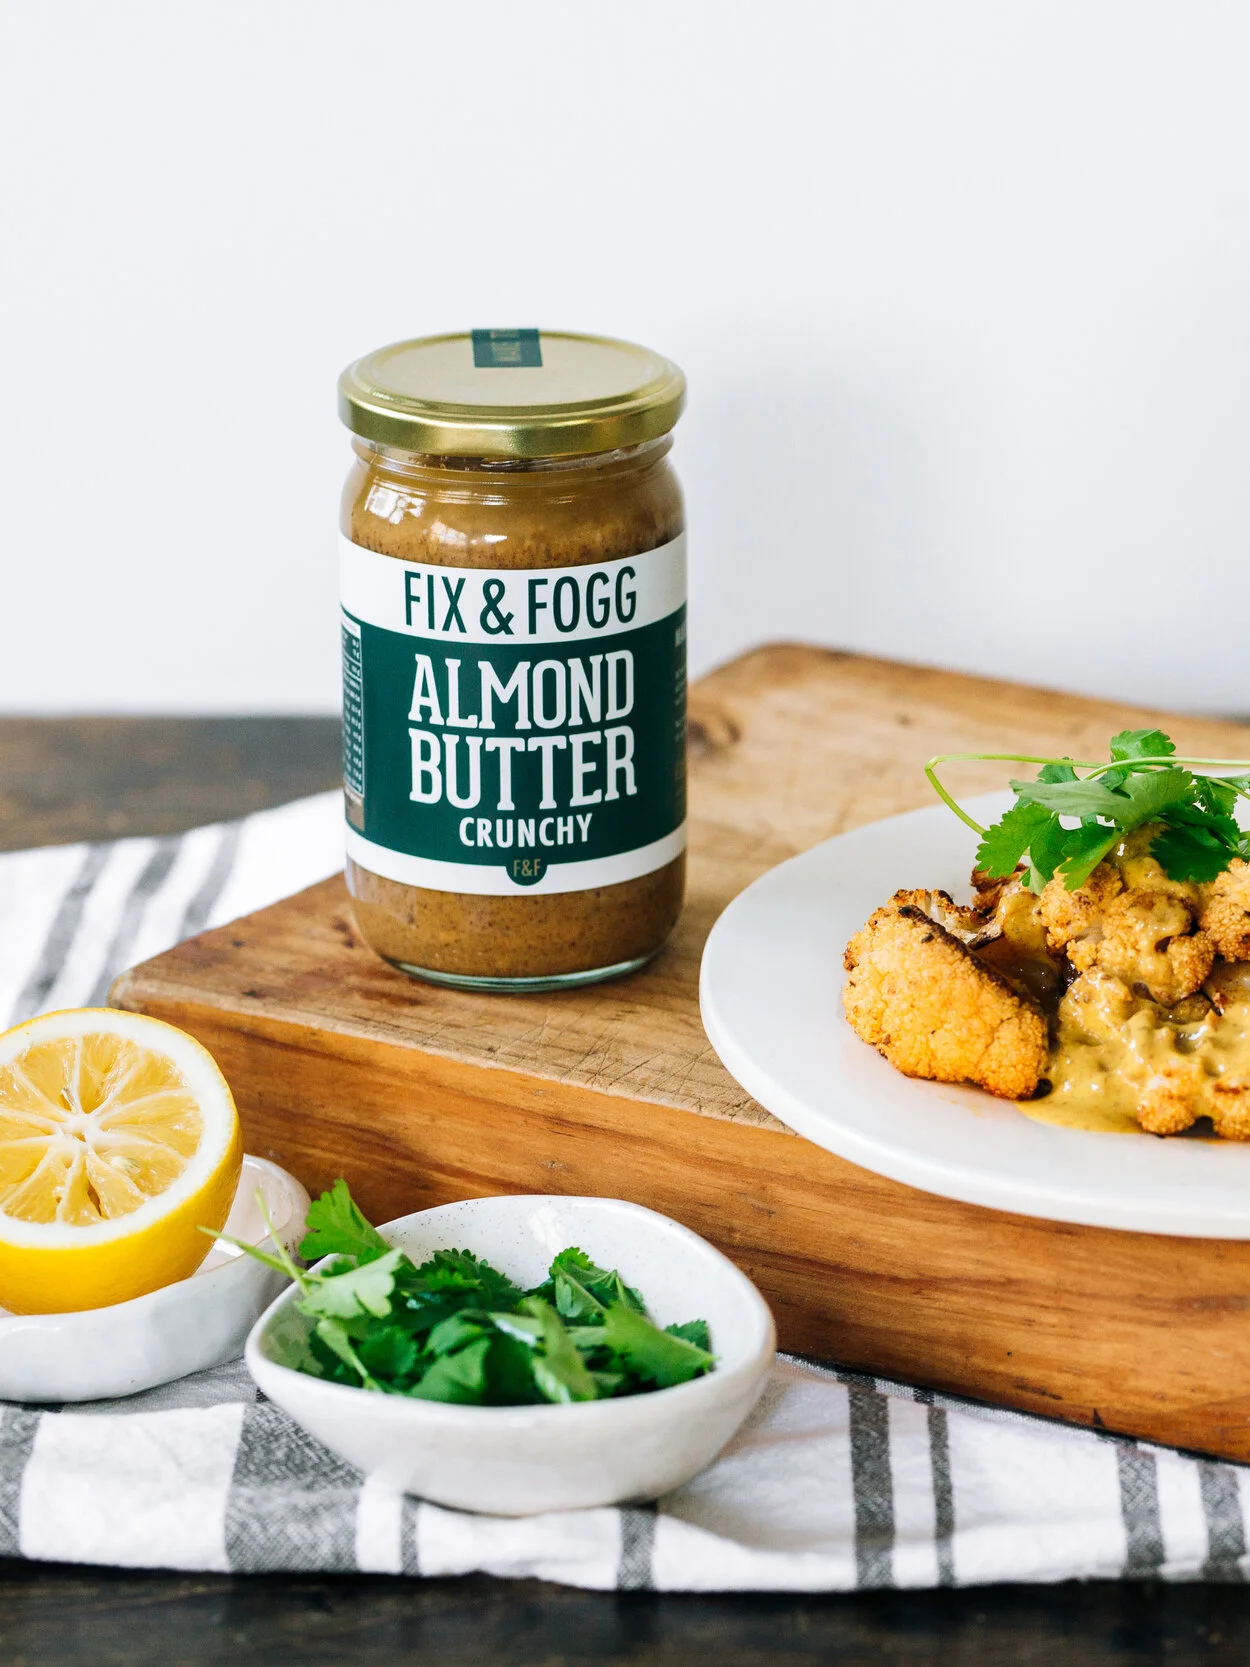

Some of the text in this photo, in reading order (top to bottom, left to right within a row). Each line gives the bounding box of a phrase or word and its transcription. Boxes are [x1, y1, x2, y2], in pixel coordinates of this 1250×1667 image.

[404, 565, 638, 636] FIX & FOGG
[407, 649, 635, 730] ALMOND
[407, 724, 638, 811] BUTTER
[458, 812, 593, 849] CRUNCHY
[512, 858, 542, 877] F&F
